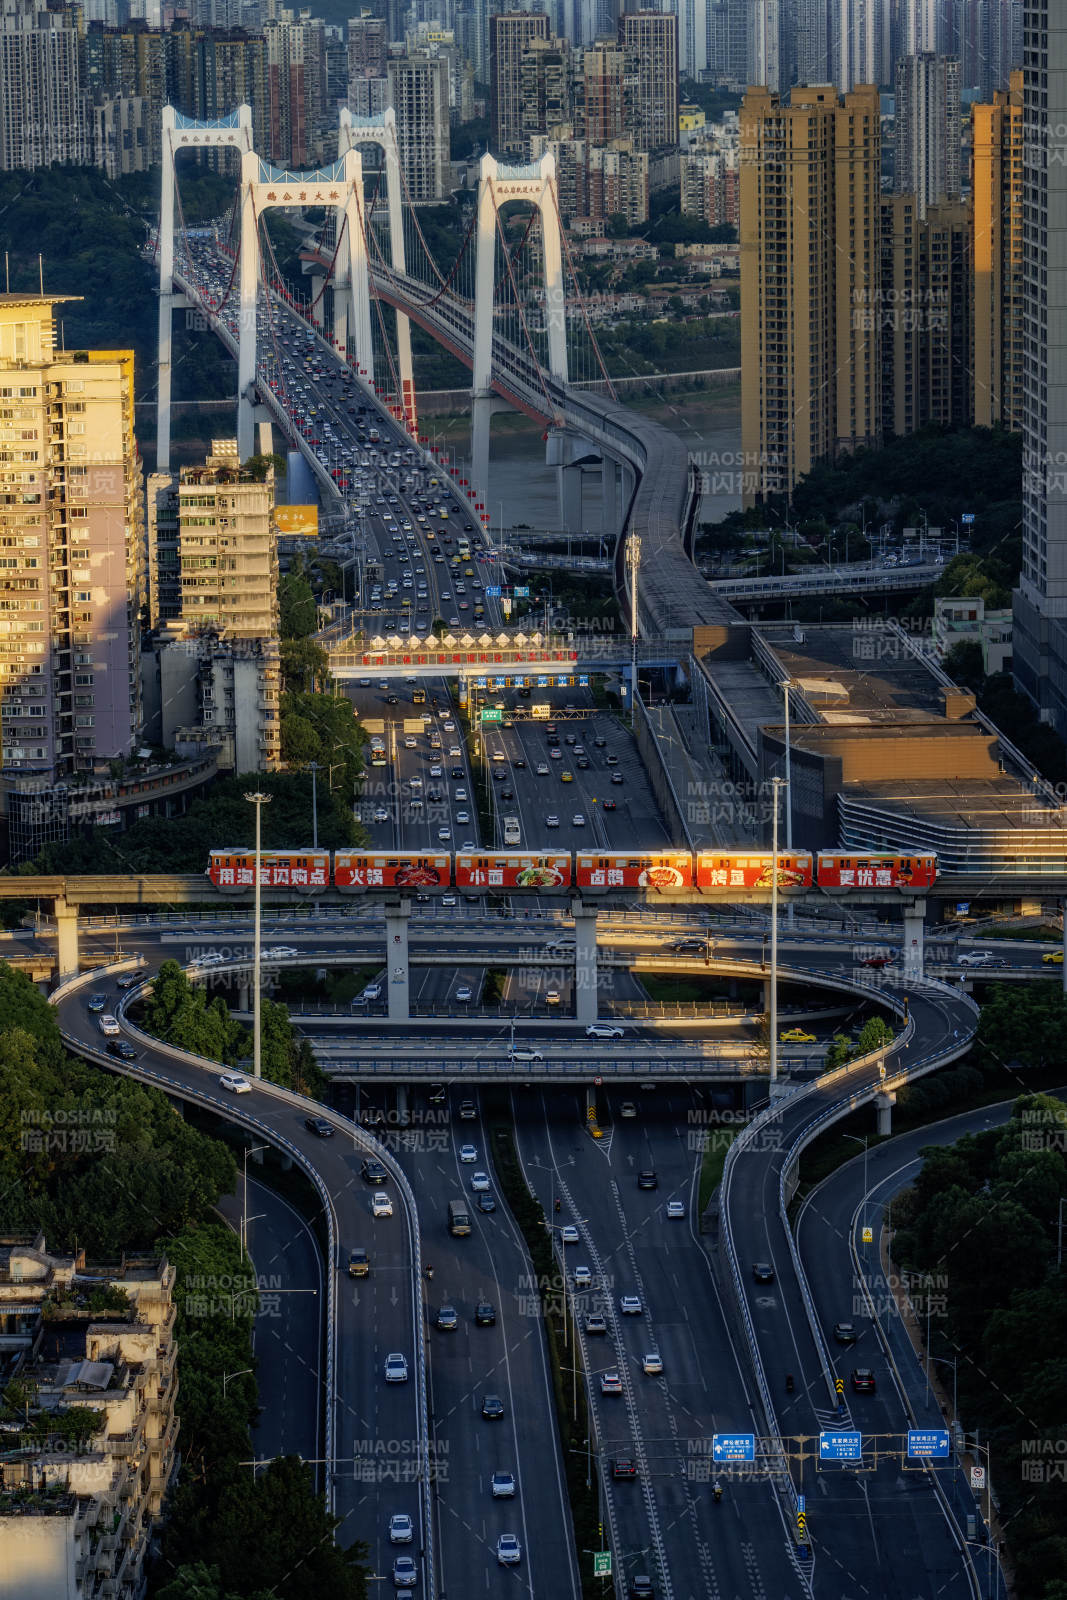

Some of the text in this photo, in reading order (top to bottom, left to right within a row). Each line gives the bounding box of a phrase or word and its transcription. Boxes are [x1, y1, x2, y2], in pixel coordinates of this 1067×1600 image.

[266, 190, 340, 202] 鹅公岩大桥
[219, 868, 326, 885] 用淘宝闪购点
[350, 868, 384, 885] 火锅
[469, 868, 504, 885] 小面
[590, 869, 624, 886] 卤鹅
[710, 869, 745, 886] 烤鱼
[839, 869, 892, 886] 更优惠
